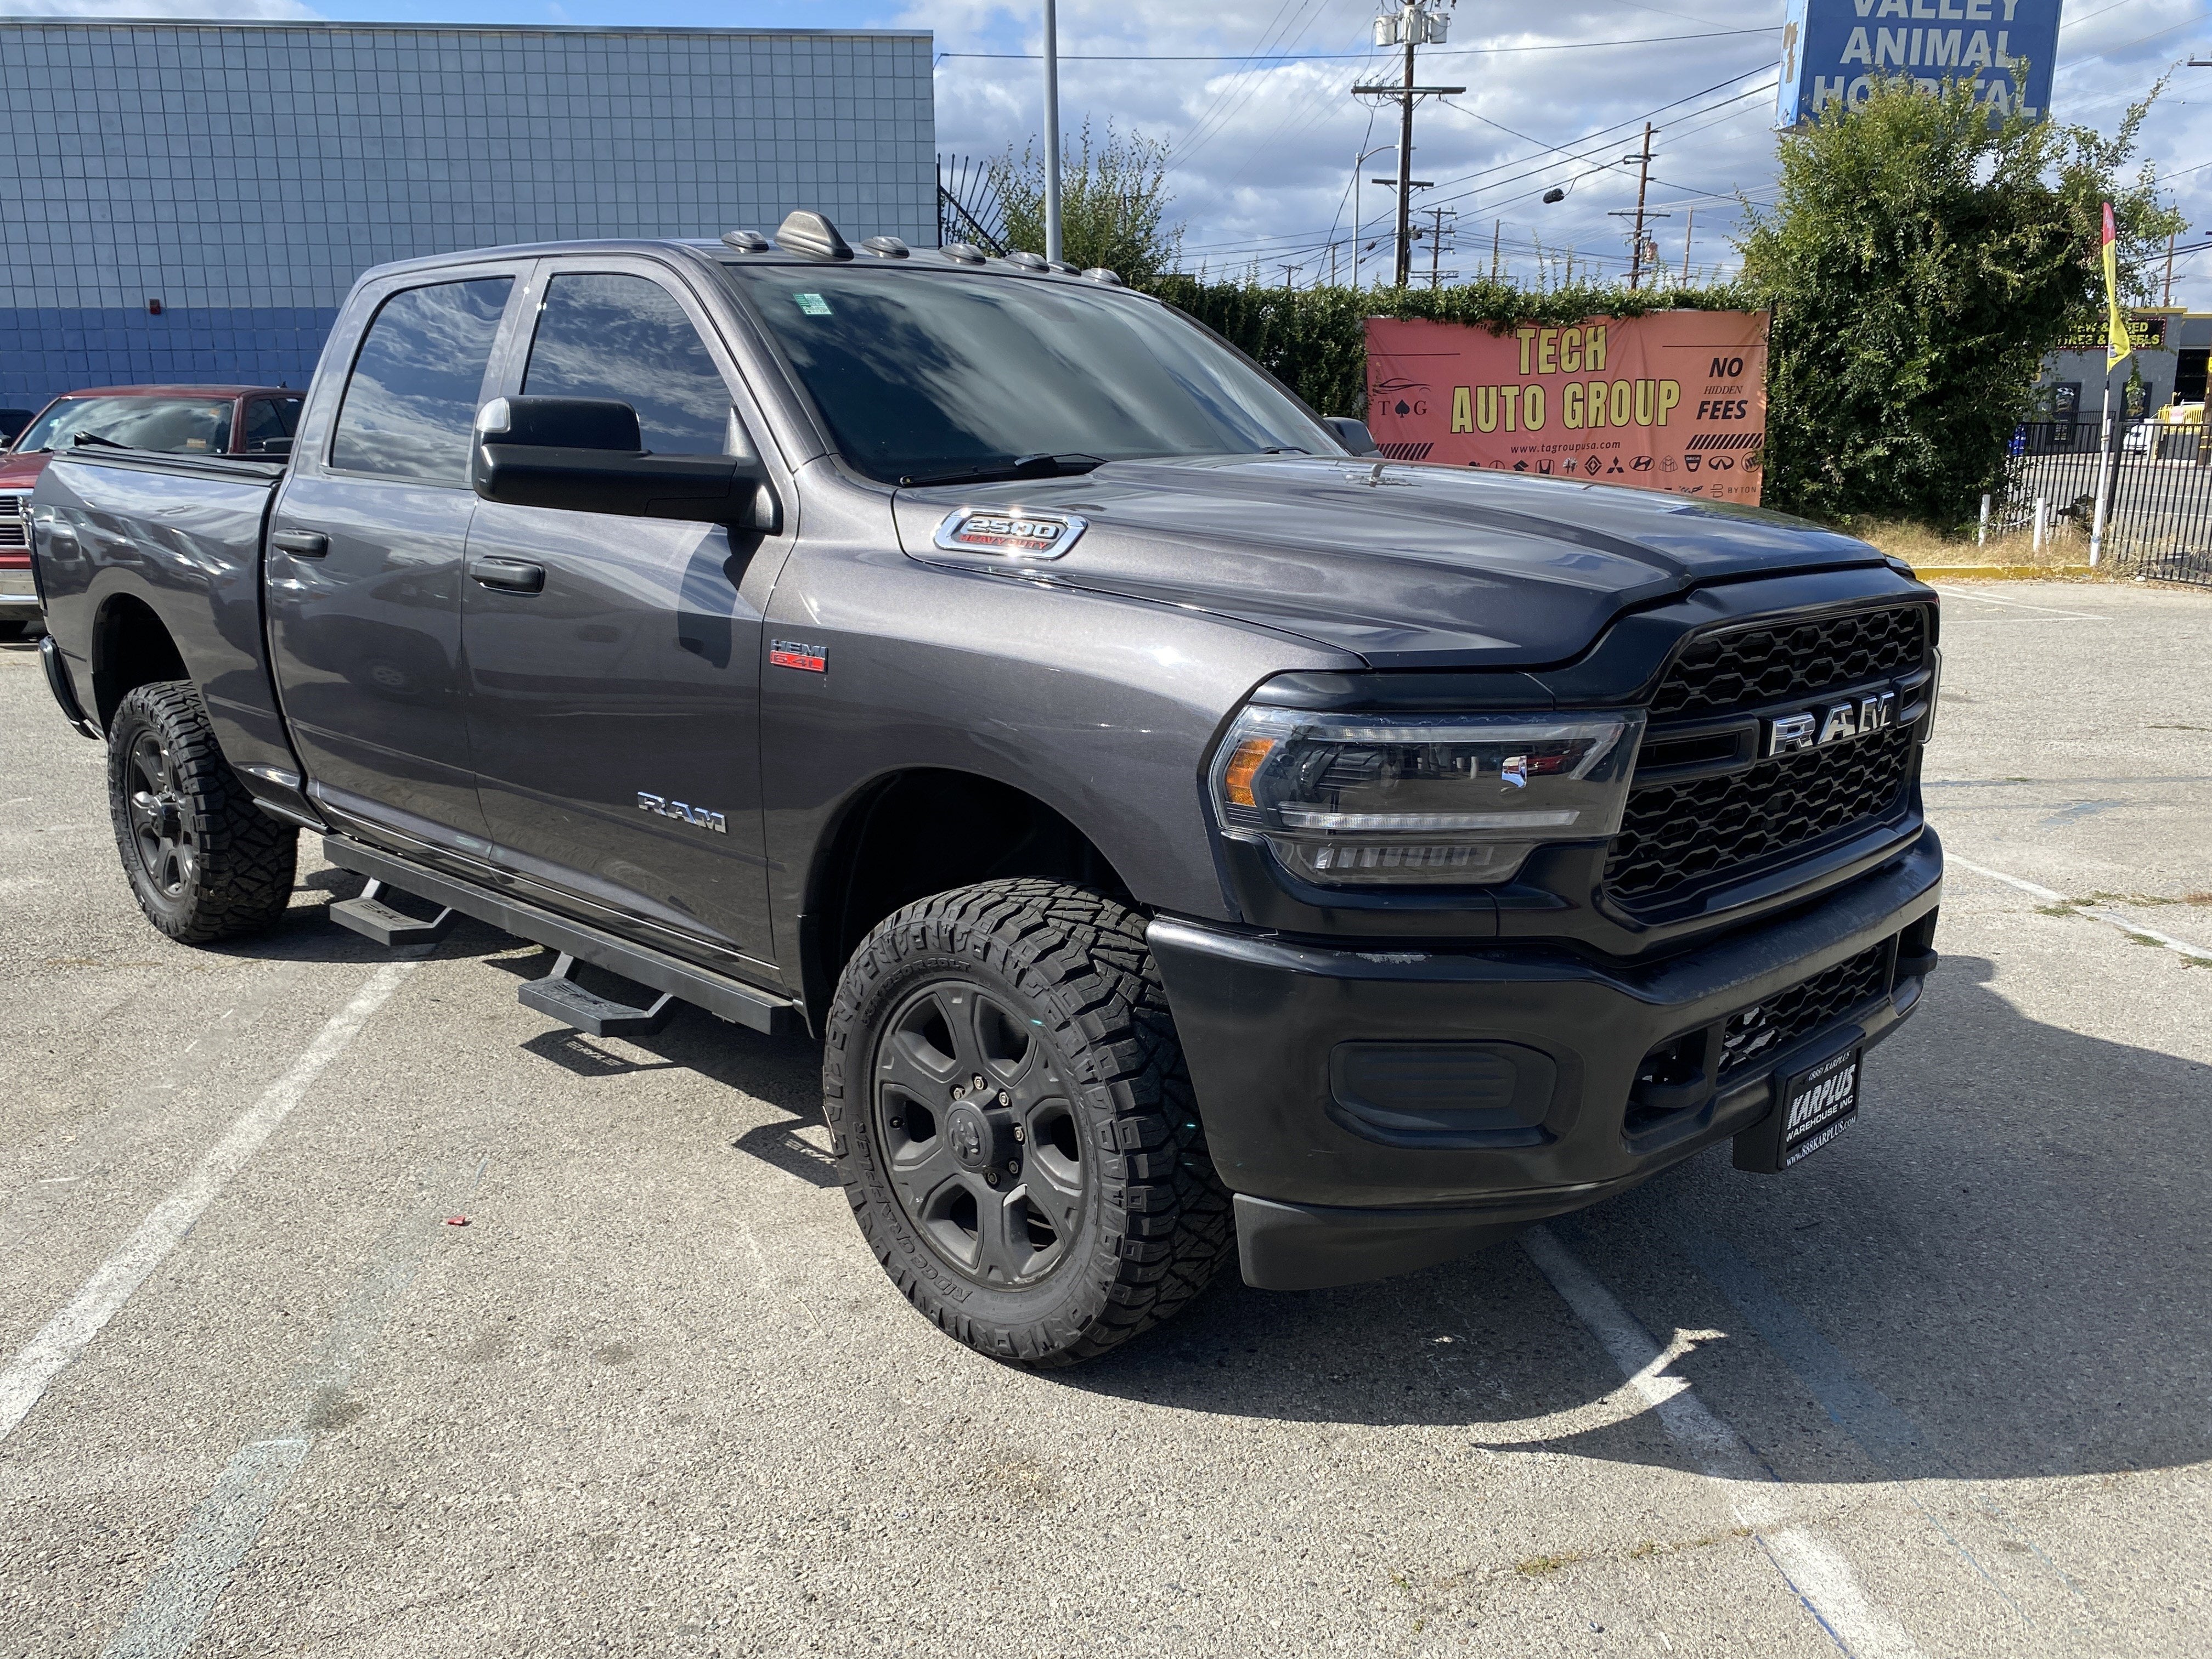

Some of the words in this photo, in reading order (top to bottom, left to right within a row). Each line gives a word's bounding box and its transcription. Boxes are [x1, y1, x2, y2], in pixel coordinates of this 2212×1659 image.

[1839, 26, 2022, 67] ANIMAL
[1516, 325, 1607, 375] TECH
[1709, 358, 1743, 377] NO
[1703, 386, 1743, 394] HIDDEN
[1451, 384, 1546, 434] AUTO
[1562, 379, 1680, 430] GROUP
[1696, 399, 1748, 420] FEES
[1511, 441, 1620, 454] www.tagroupusa.com
[960, 534, 1006, 545] HEAVY
[1007, 539, 1051, 549] DUTY
[967, 519, 1059, 539] 2500
[770, 639, 828, 659] HEMI
[1769, 690, 1895, 757] RAM
[637, 791, 727, 834] RAM
[1787, 1063, 1856, 1130] KARPLUS
[1786, 1104, 1837, 1142] WAREHOUSE
[1839, 1095, 1854, 1109] INC
